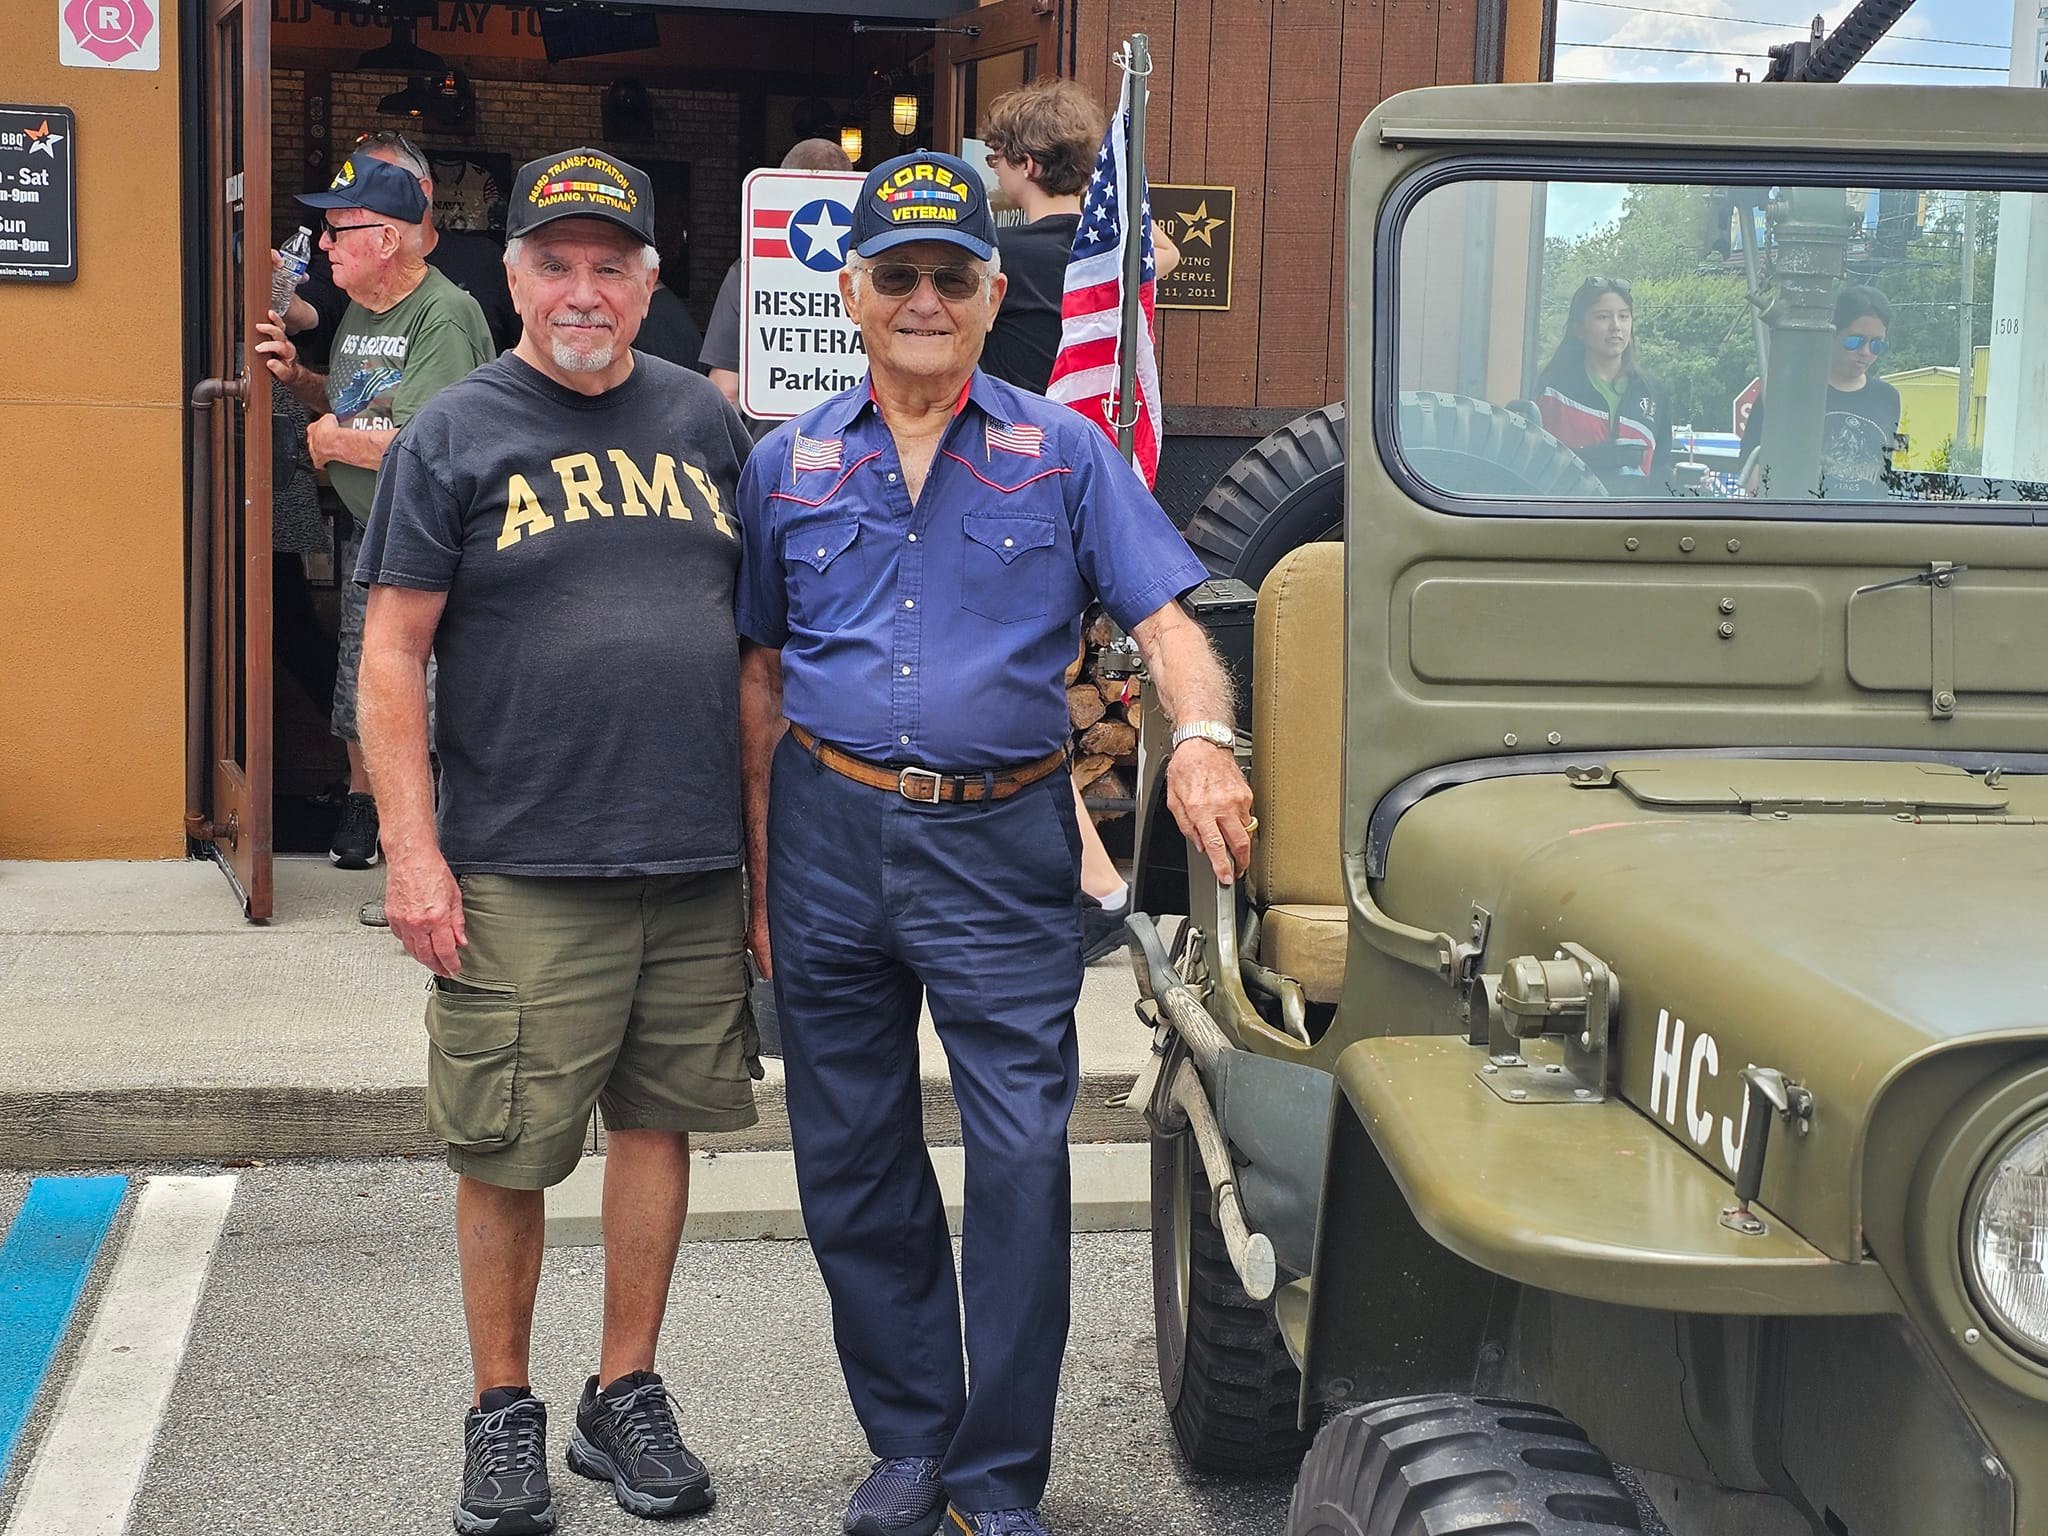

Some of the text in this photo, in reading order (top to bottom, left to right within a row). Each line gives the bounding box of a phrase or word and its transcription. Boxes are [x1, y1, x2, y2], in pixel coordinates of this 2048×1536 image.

[99, 6, 122, 30] R
[2, 133, 23, 147] BBQ
[19, 167, 50, 186] Sat
[548, 155, 630, 190] TRANSPORTATION
[876, 164, 969, 203] KOREA
[537, 192, 631, 213] DANANG, VIETNAM
[891, 206, 957, 221] VETERAN
[1173, 272, 1216, 282] SERVE.
[1164, 287, 1182, 297] 11,
[1188, 288, 1217, 298] 2011
[754, 290, 851, 318] RESER
[1995, 318, 2019, 336] 1508
[496, 449, 735, 551] ARMY
